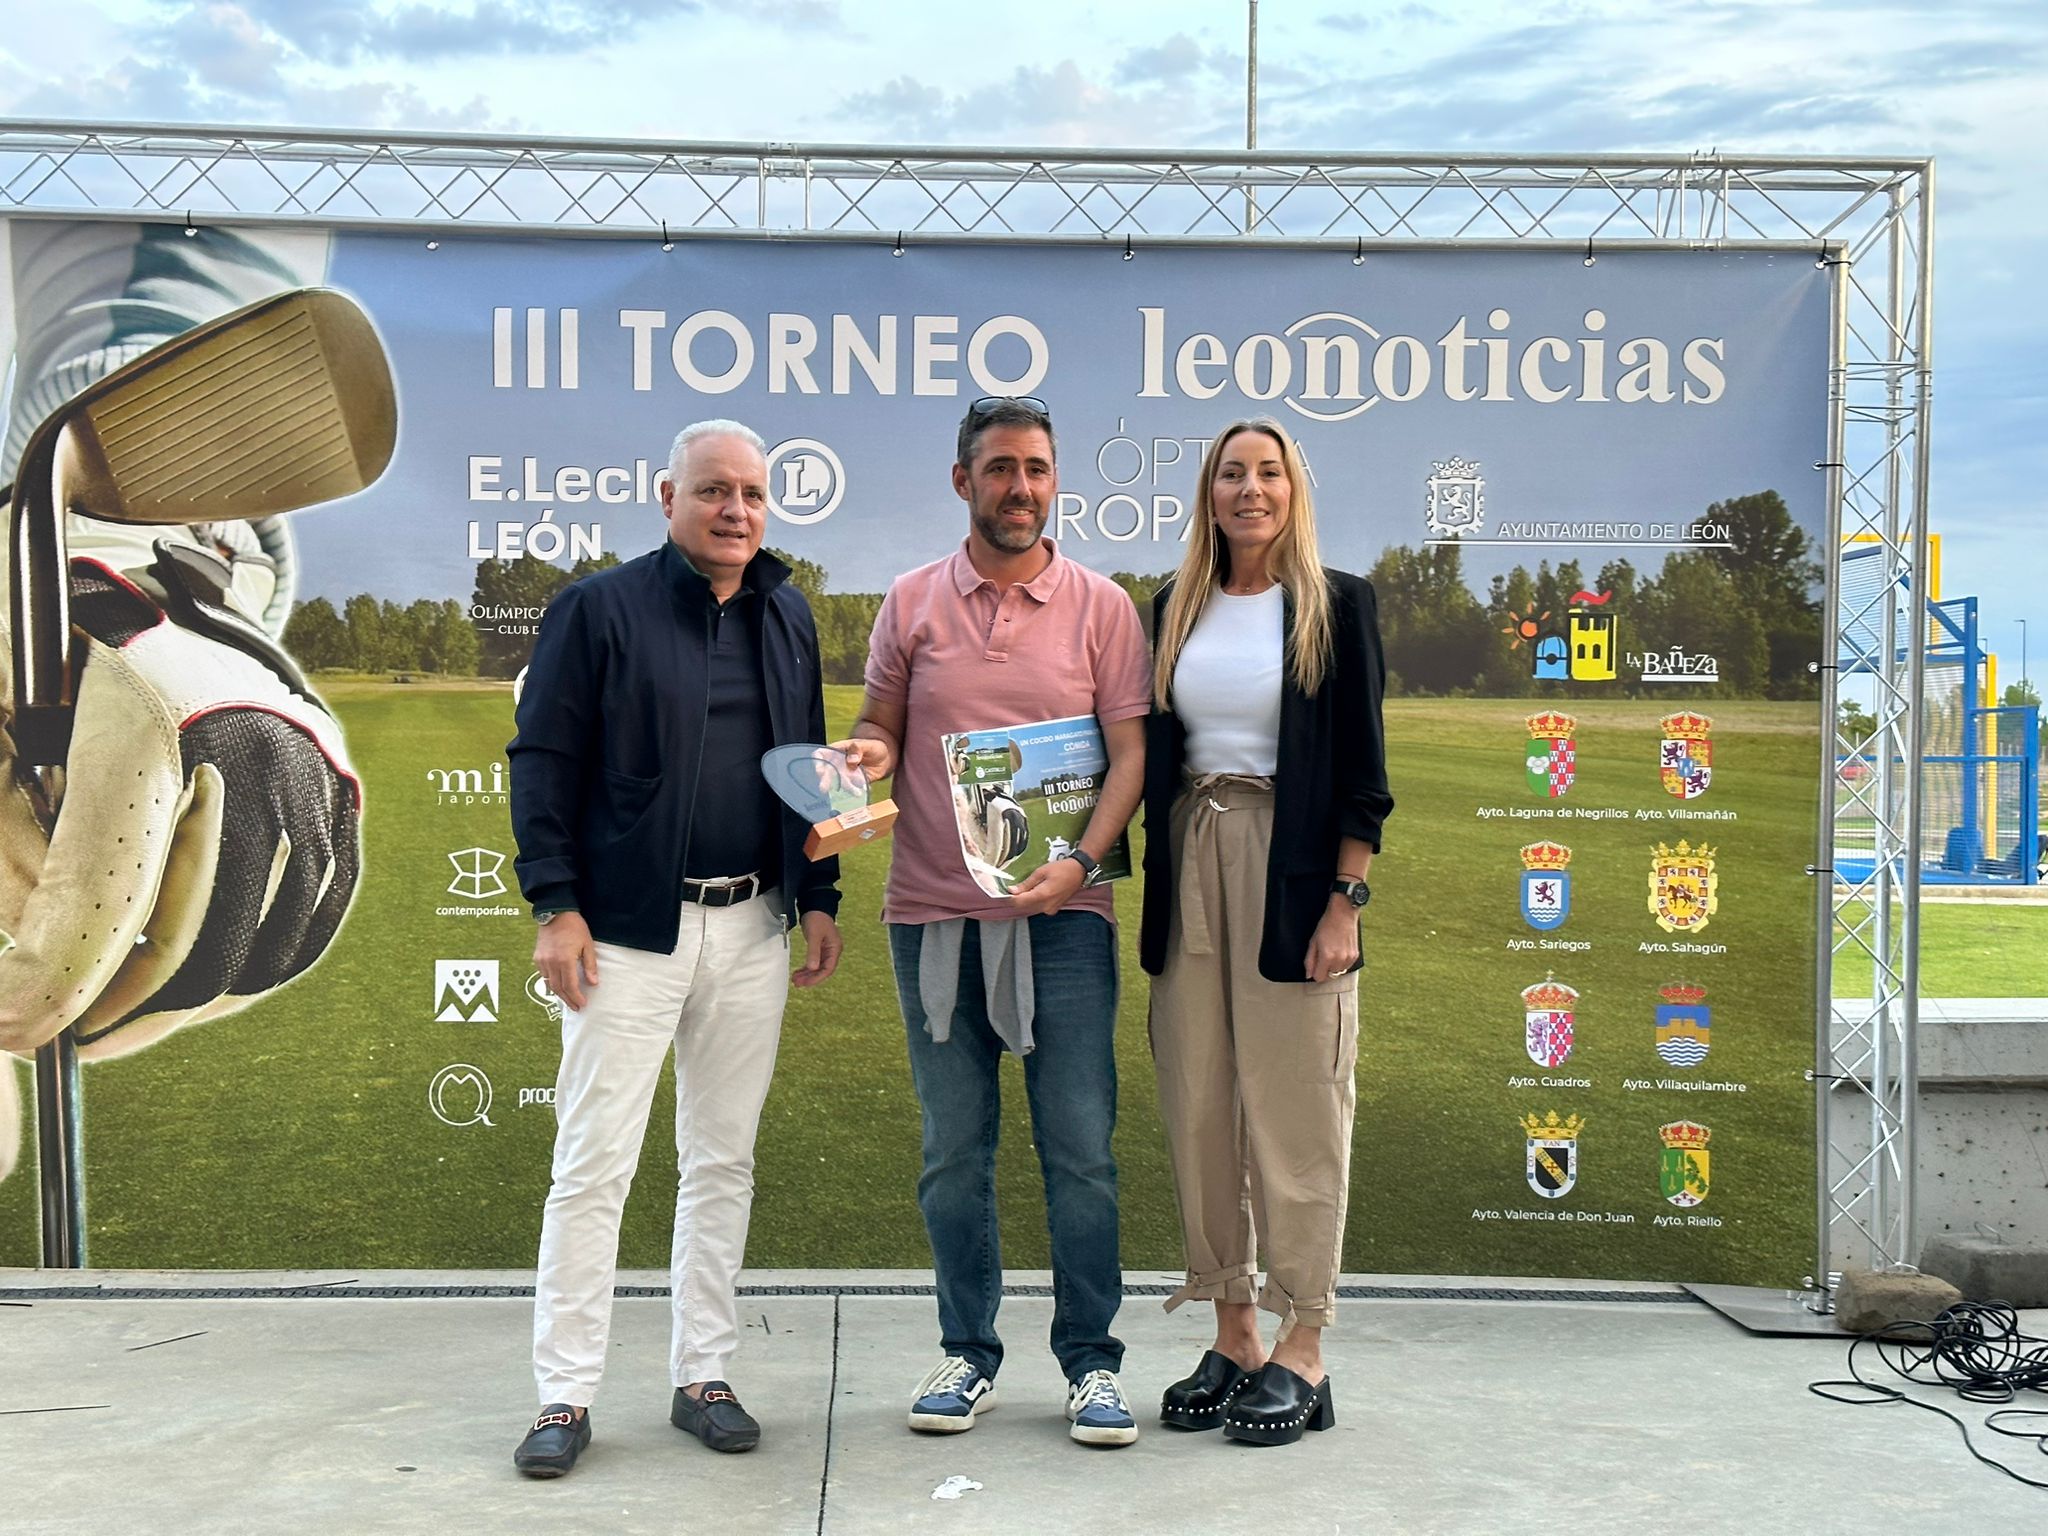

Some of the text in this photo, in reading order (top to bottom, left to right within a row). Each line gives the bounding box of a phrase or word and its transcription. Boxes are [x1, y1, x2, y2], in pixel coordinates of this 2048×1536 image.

[493, 308, 1050, 398] III TORNEO
[1137, 306, 1726, 410] leonoticias
[1056, 492, 1195, 543] ROP
[467, 510, 602, 561] LEÓN
[1498, 522, 1731, 541] AYUNTAMIENTO DE LEÓN
[498, 625, 529, 635] CLUB
[1029, 734, 1054, 746] COCIDO
[1044, 776, 1094, 797] III TORNEO
[1476, 807, 1629, 821] Ayto. Laguna de Negrillos
[1635, 808, 1737, 821] Ayto. Villamañán
[436, 905, 520, 918] contemporánea
[1506, 939, 1592, 953] Ayto. Sariegos
[1638, 942, 1727, 955] Ayto. Sahagún
[1508, 1077, 1592, 1089] Ayto. Cuadros
[1622, 1079, 1747, 1094] Ayto. Villaquilambre
[1471, 1209, 1635, 1224] Ayto. Valencia de Don Juan
[1653, 1215, 1723, 1228] Ayto. Riello
